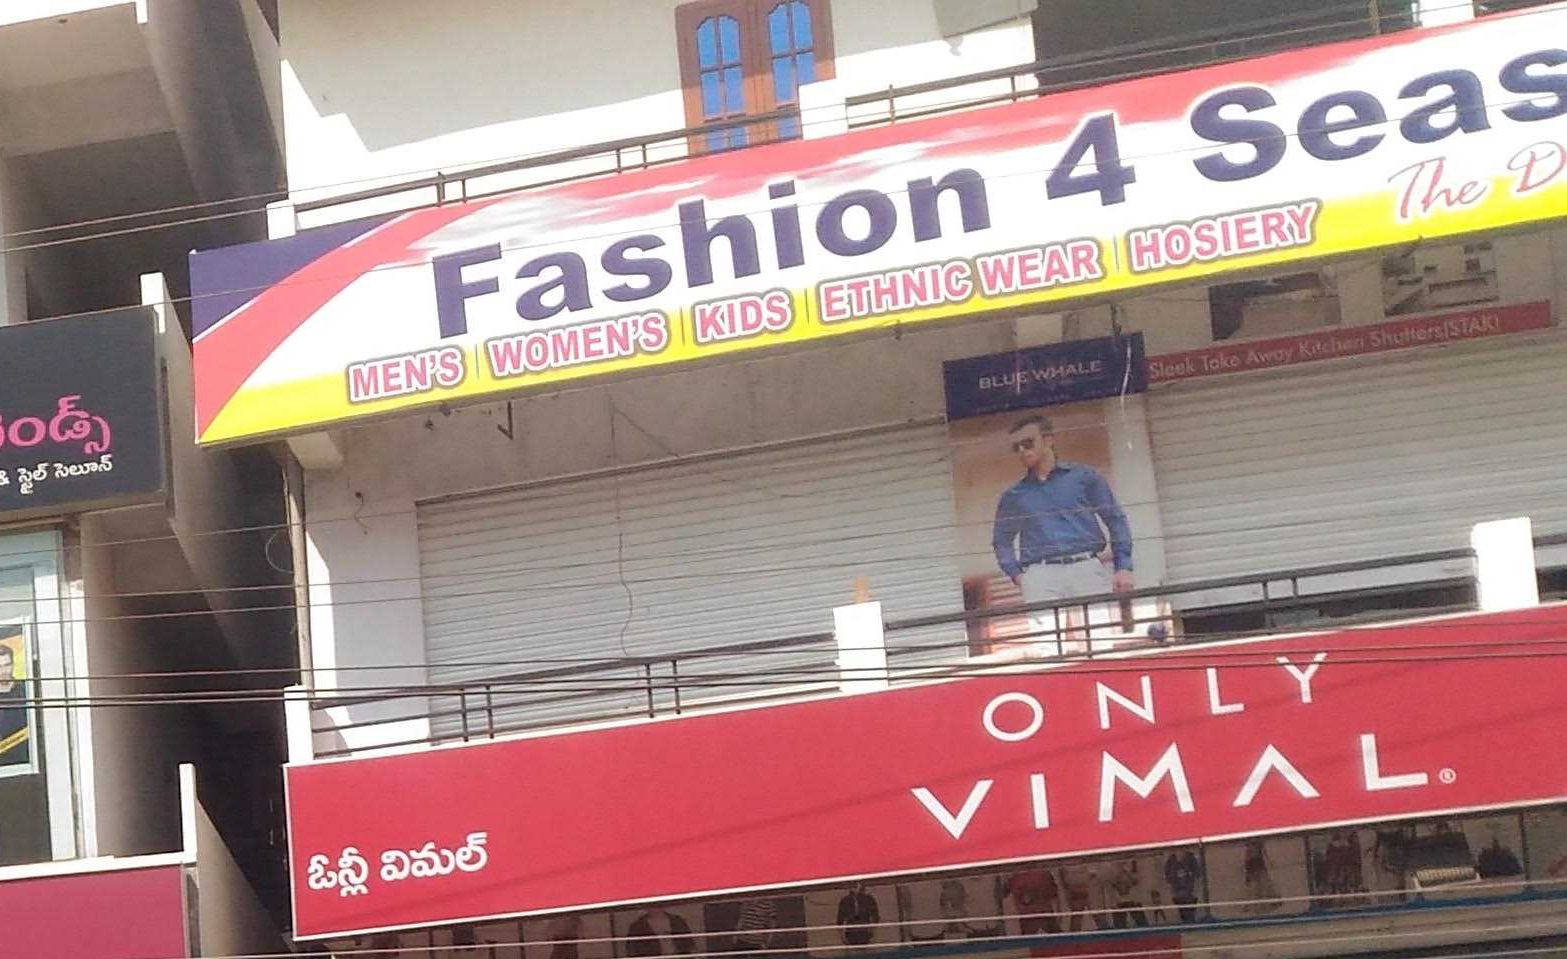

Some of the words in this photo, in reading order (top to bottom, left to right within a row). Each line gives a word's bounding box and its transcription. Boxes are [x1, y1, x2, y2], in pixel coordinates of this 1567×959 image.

[432, 167, 992, 340] Fashion
[1045, 112, 1137, 207] 4
[1189, 48, 1567, 183] Seas
[1388, 156, 1488, 220] The
[350, 349, 464, 401] MEN'S
[494, 317, 667, 374] WOMEN'S
[697, 295, 789, 339] KIDS
[822, 263, 971, 319] ETHNIC
[982, 244, 1100, 293] WEAR
[1133, 203, 1316, 268] HOSIERY
[978, 370, 1028, 390] BLUE
[1032, 359, 1103, 382] WHALE
[1149, 357, 1195, 379] Sleek
[1201, 354, 1241, 375] Take
[1245, 347, 1293, 367] Away
[982, 651, 1328, 742] ONLY
[910, 732, 1429, 841] VIMAL
[307, 846, 370, 898] ఓన్లీ
[380, 831, 489, 882] విమల్
